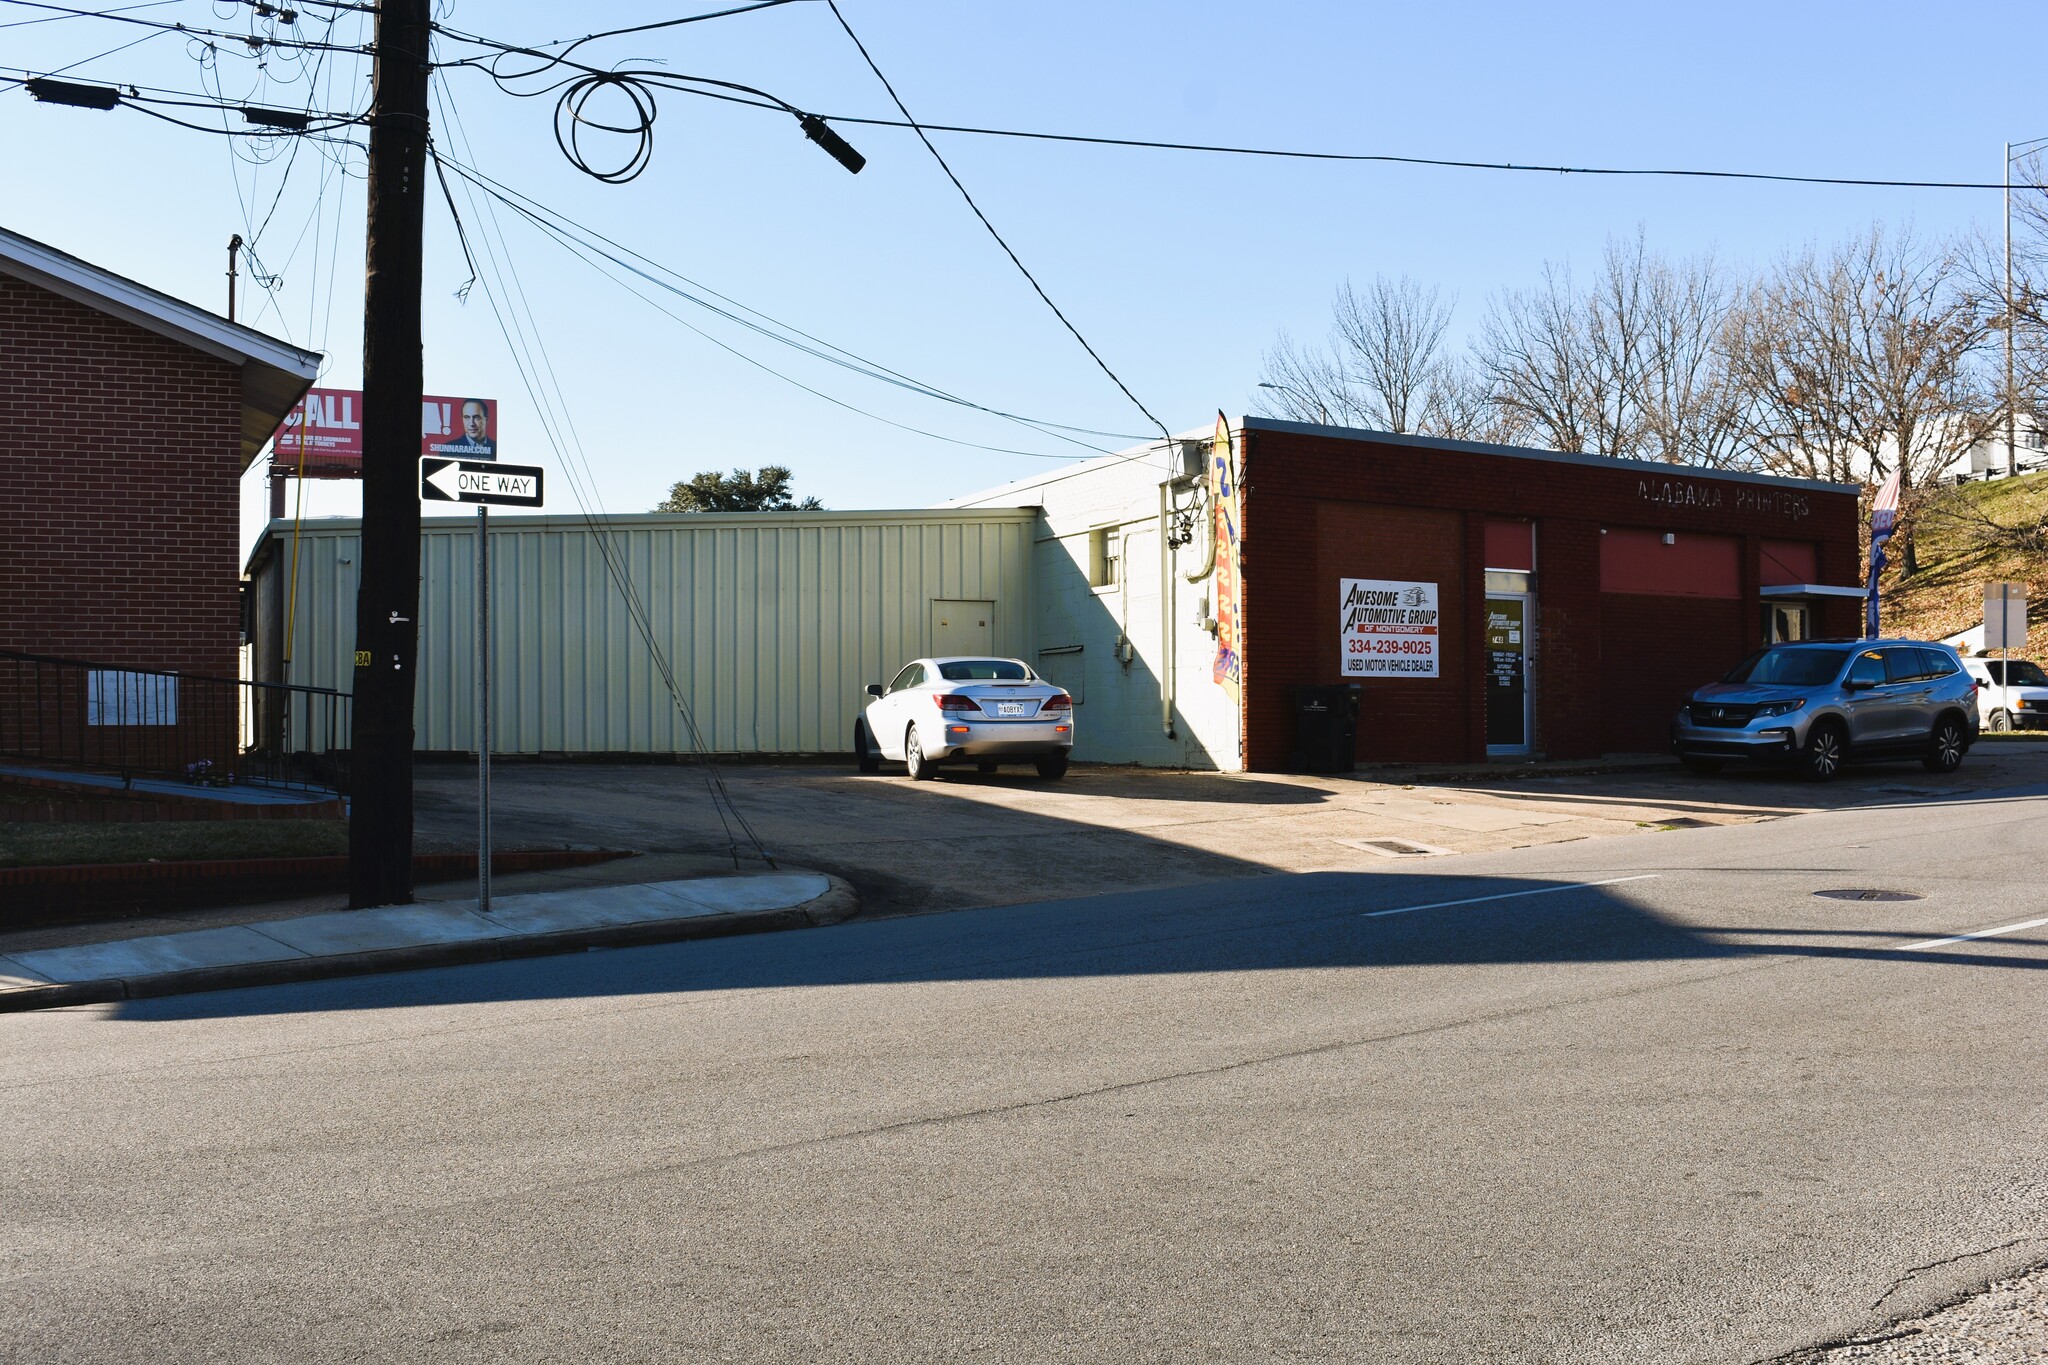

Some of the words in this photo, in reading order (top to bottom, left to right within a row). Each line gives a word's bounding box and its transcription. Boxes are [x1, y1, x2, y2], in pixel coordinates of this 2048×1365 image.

[429, 443, 491, 455] SHUNNARAH.COM
[458, 473, 491, 492] ONE
[497, 476, 531, 494] WAY
[1638, 480, 1722, 507] ALABAMA
[1343, 583, 1399, 610] AWESOME
[1343, 607, 1406, 634] AUTOMOTIVE
[1408, 609, 1437, 625] GROUP
[1376, 625, 1424, 633] MONTGOMERY
[1349, 639, 1432, 654] 334-239-9025
[1348, 659, 1363, 671] USED
[1365, 659, 1387, 671] MOTOR
[1388, 660, 1410, 672] VEHICLE
[1411, 660, 1433, 672] DEALER
